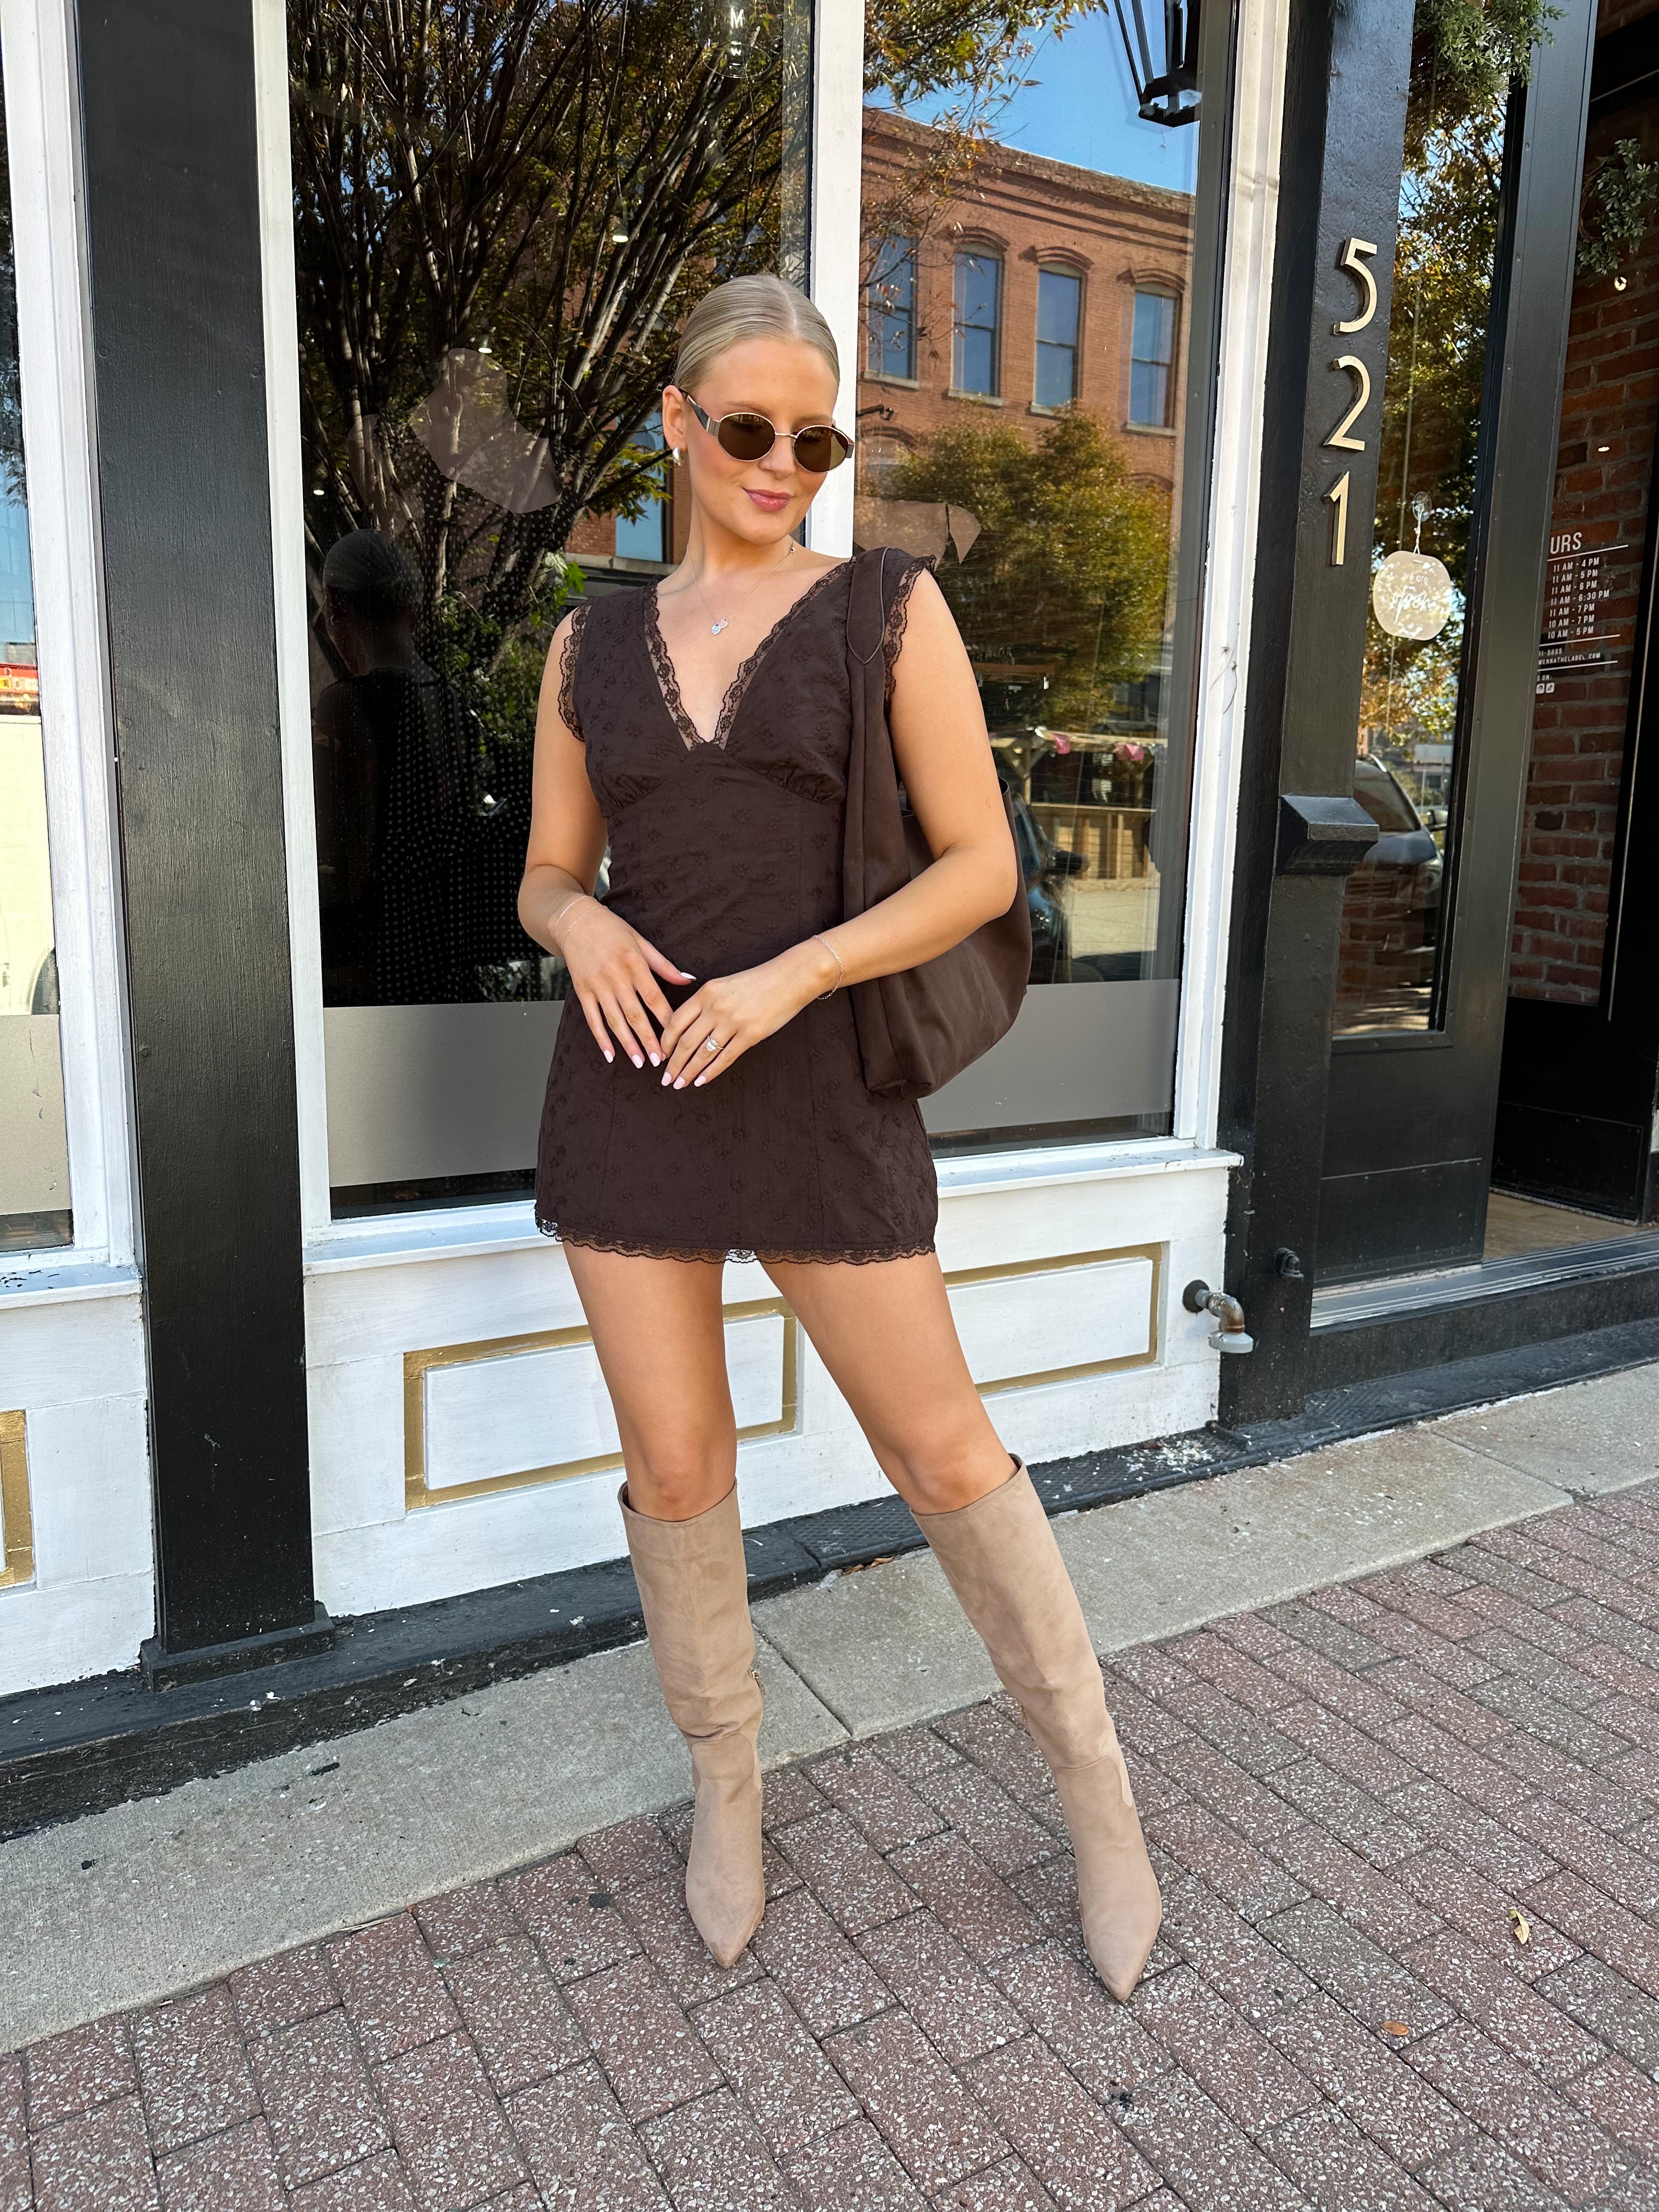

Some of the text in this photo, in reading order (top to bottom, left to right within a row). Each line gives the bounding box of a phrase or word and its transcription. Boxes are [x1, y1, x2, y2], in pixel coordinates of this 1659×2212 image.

[1323, 237, 1378, 566] 521
[1554, 564, 1560, 573] 11
[1562, 561, 1573, 571] AM
[1581, 559, 1586, 567] 4
[1588, 557, 1599, 567] PM
[1403, 572, 1429, 583] we are
[1553, 575, 1559, 584] 11
[1561, 573, 1572, 582] AM
[1581, 571, 1585, 579] 5
[1587, 569, 1598, 578] PM
[1551, 586, 1558, 595] 11
[1560, 584, 1571, 594] AM
[1579, 582, 1584, 590] 6
[1585, 580, 1597, 589] PM
[1550, 597, 1557, 606] 11
[1559, 595, 1571, 605] AM
[1578, 591, 1596, 602] 6:30
[1598, 589, 1610, 599] PM
[1550, 609, 1556, 617] 11
[1558, 607, 1570, 616] AM
[1578, 605, 1582, 613] 7
[1583, 603, 1595, 612] PM
[1549, 619, 1556, 628] 10
[1558, 618, 1570, 627] AM
[1577, 616, 1582, 624] 7
[1583, 614, 1595, 624] PM
[1548, 631, 1556, 640] 10
[1557, 629, 1568, 638] AM
[1576, 627, 1581, 636] 5
[1583, 625, 1594, 635] PM
